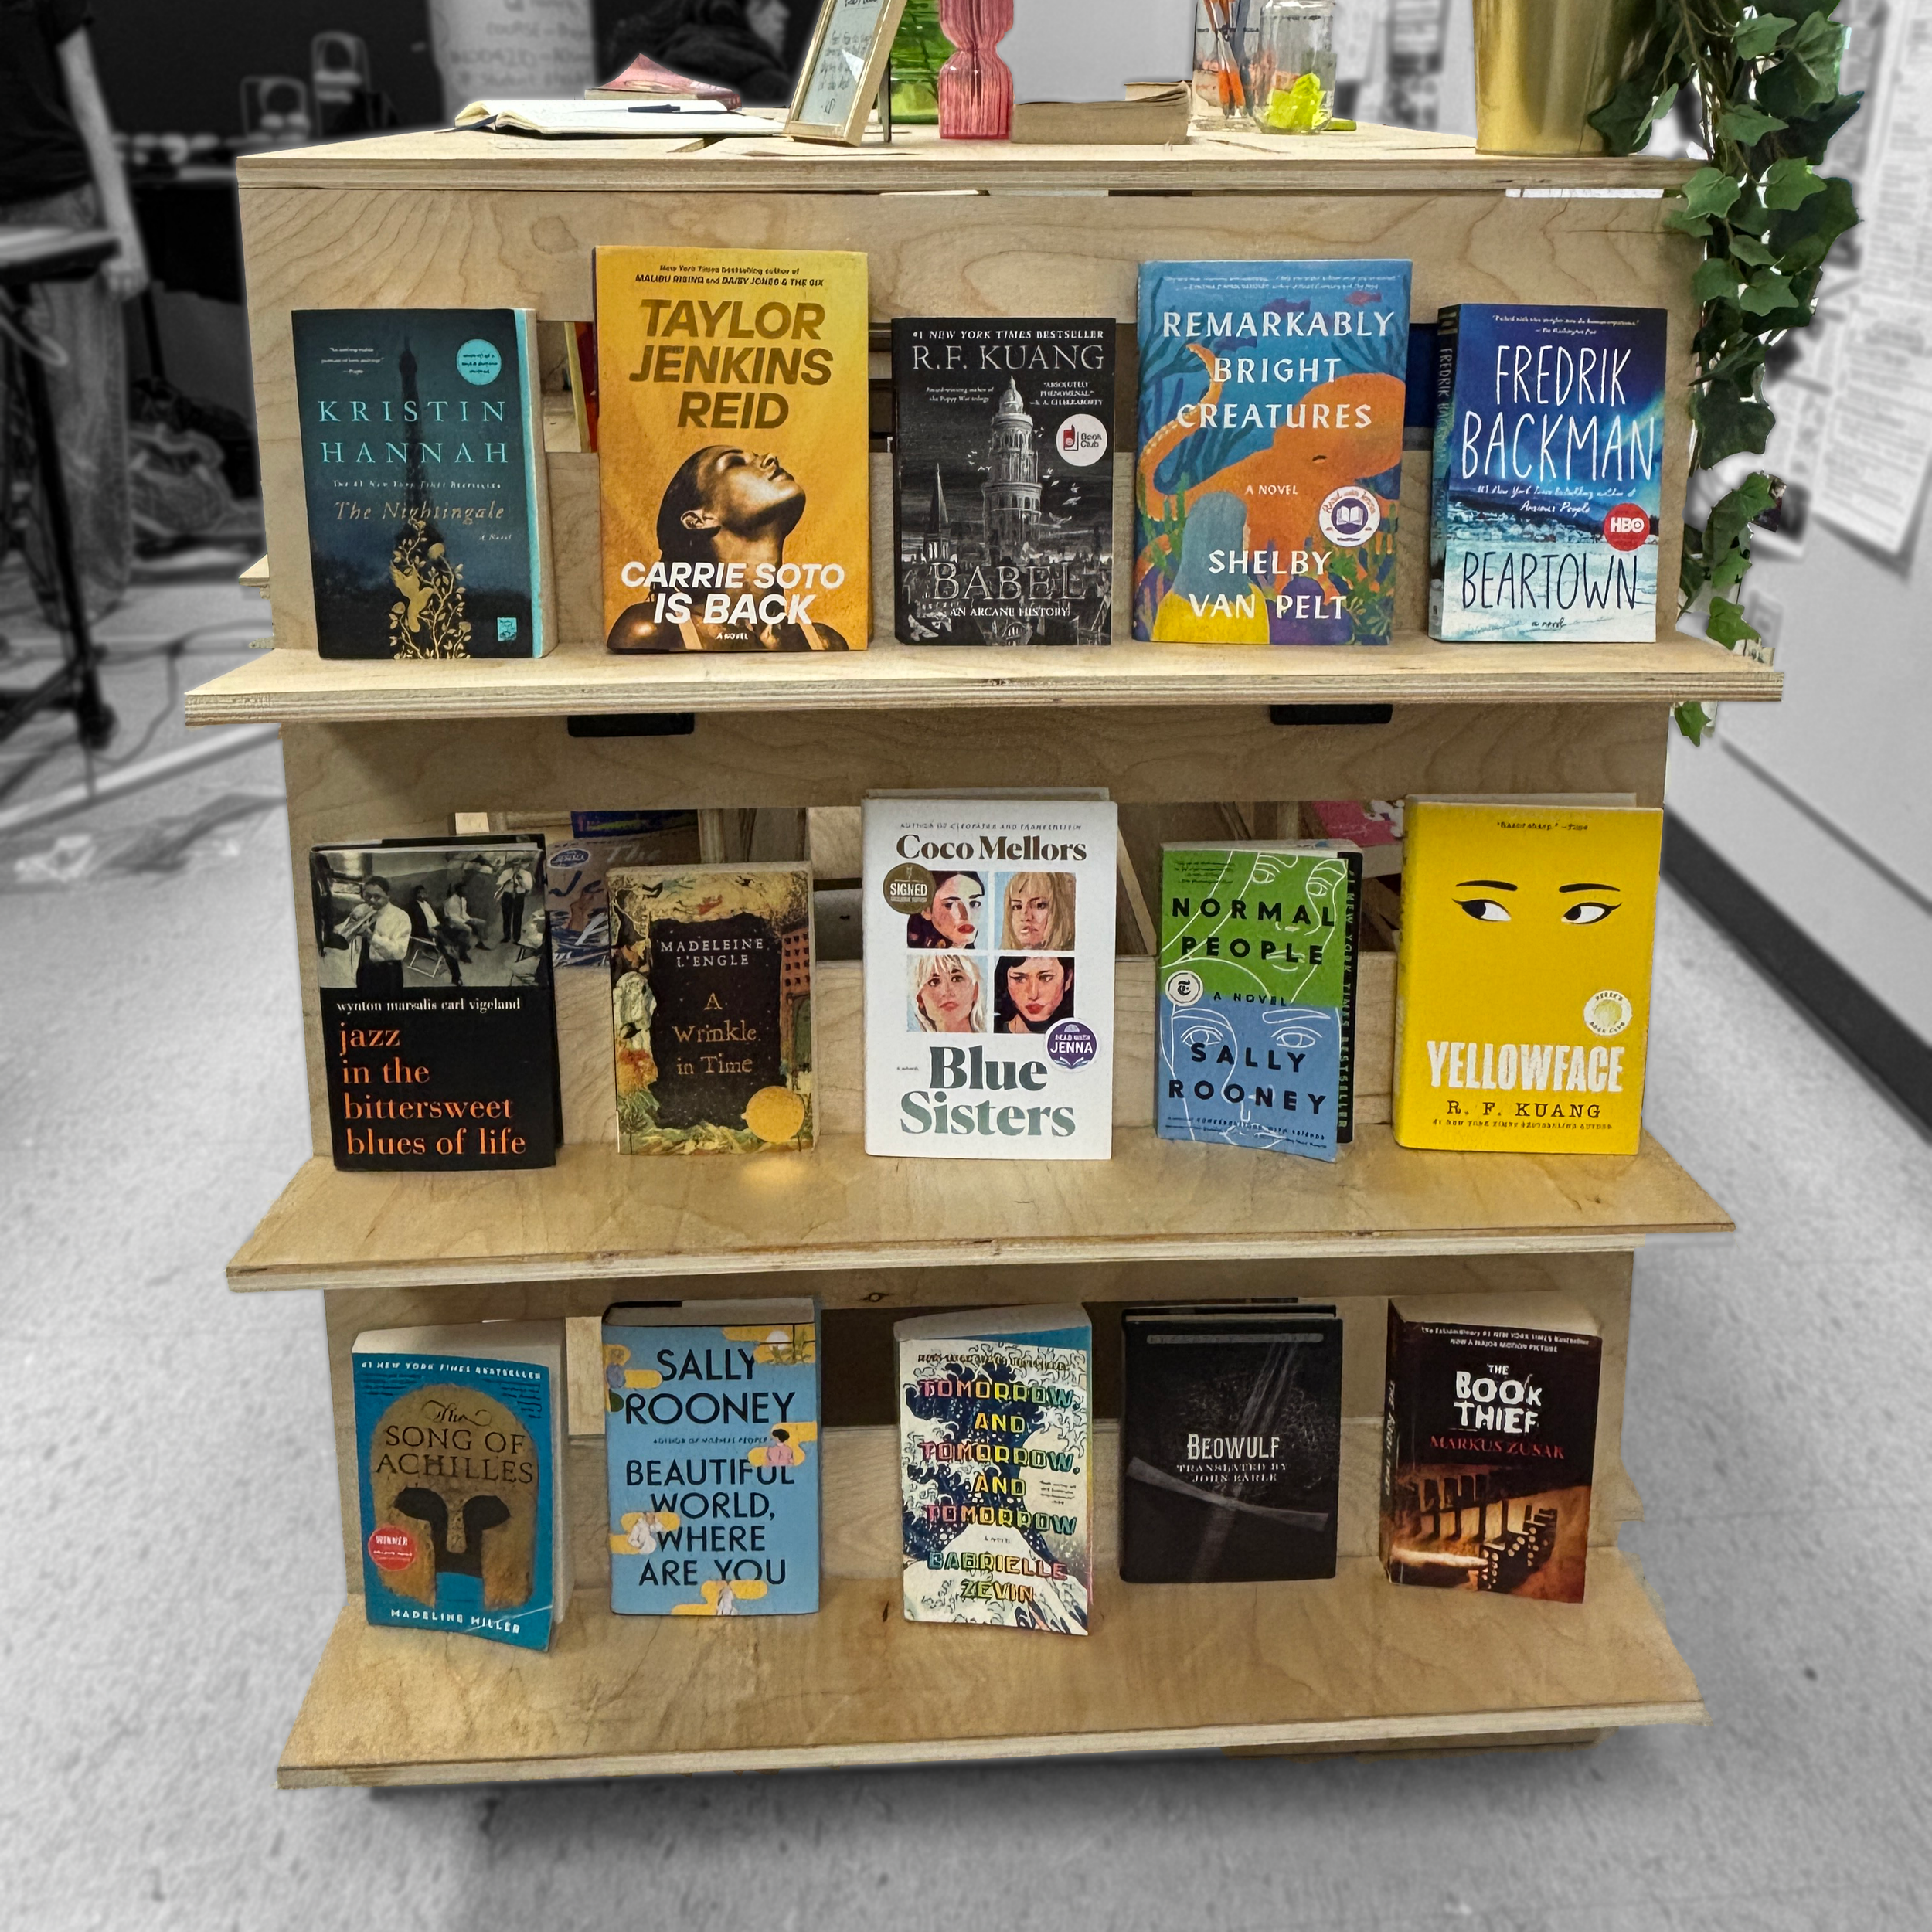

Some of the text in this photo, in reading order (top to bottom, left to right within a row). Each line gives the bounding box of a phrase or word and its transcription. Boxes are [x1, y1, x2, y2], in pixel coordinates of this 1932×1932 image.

[639, 298, 825, 341] TAYLOR
[1163, 311, 1394, 338] REMARKABLY
[929, 330, 957, 339] NEW
[961, 330, 992, 339] YORK
[995, 330, 1032, 339] TIMES
[1036, 330, 1104, 339] BESTSELLER
[629, 345, 834, 386] JENKINS
[978, 345, 1104, 370] KUANG
[1213, 357, 1342, 383] BRIGHT
[1496, 345, 1631, 407] FREDRIK
[318, 400, 506, 422] KRISTIN
[677, 392, 789, 430] REID
[1176, 403, 1372, 430] CREATURES
[1080, 432, 1102, 440] Book
[1461, 410, 1655, 482] BACKMAN
[321, 442, 509, 464] HANNAH
[1244, 485, 1299, 496] A NOVEL
[334, 500, 505, 525] The Nightingale
[1560, 502, 1590, 518] People
[1610, 517, 1645, 533] HBO
[621, 561, 845, 590] CARRIE SOTO
[1208, 549, 1332, 576] SHELBY
[928, 561, 1086, 601] BABEL
[1461, 551, 1638, 610] BEARTOWN
[653, 592, 818, 626] IS BACK
[949, 606, 1068, 617] AN ARCANE HISTORY
[1189, 594, 1347, 620] VAN PELT
[896, 834, 1087, 861] Coco Mellors
[889, 883, 928, 896] SIGNED
[1172, 897, 1335, 927] NORMAL
[660, 938, 764, 953] MADELEINE
[1182, 936, 1324, 965] PEOPLE
[676, 955, 750, 968] L'ENGLE
[337, 997, 521, 1015] wynton marsalis carl vigeland
[703, 992, 723, 1011] A
[1213, 992, 1287, 1006] A NOVEL
[338, 1022, 401, 1056] jazz
[672, 1019, 757, 1043] Wrinkle
[1050, 1041, 1093, 1054] JENNA
[1190, 1043, 1306, 1073] SALLY
[343, 1056, 430, 1085] in the
[677, 1054, 753, 1075] in Time
[929, 1046, 1048, 1091] Blue
[1427, 1040, 1625, 1093] YELLOWFACE
[344, 1092, 514, 1120] bittersweet
[1168, 1080, 1327, 1115] ROONEY
[1447, 1100, 1601, 1118] R. F. KUANG
[900, 1090, 1077, 1138] Sisters
[346, 1127, 526, 1155] blues of life
[656, 1348, 756, 1381] SALLY
[1486, 1363, 1510, 1376] THE
[1455, 1370, 1543, 1407] BOOK
[625, 1392, 797, 1425] ROONEY
[1452, 1400, 1539, 1434] THIEF
[974, 1412, 1026, 1434] AND
[386, 1425, 526, 1455] SONG OF
[1430, 1434, 1566, 1460] MARKUS ZUSAK
[375, 1453, 534, 1485] ACHILLES
[626, 1458, 795, 1486] BEAUTIFUL
[1176, 1463, 1266, 1473] TRANSLATED
[1192, 1474, 1229, 1483] JOHN
[973, 1475, 1027, 1498] AND
[650, 1492, 776, 1521] WORLD,
[924, 1503, 1079, 1536] TOMORROW
[376, 1535, 408, 1546] WINNER
[657, 1525, 767, 1553] WHERE
[638, 1559, 787, 1587] ARE YOU
[927, 1550, 1069, 1581] GABRIELLE
[960, 1580, 1036, 1604] ZEVIN
[390, 1609, 522, 1634] MADELINE MILLER
